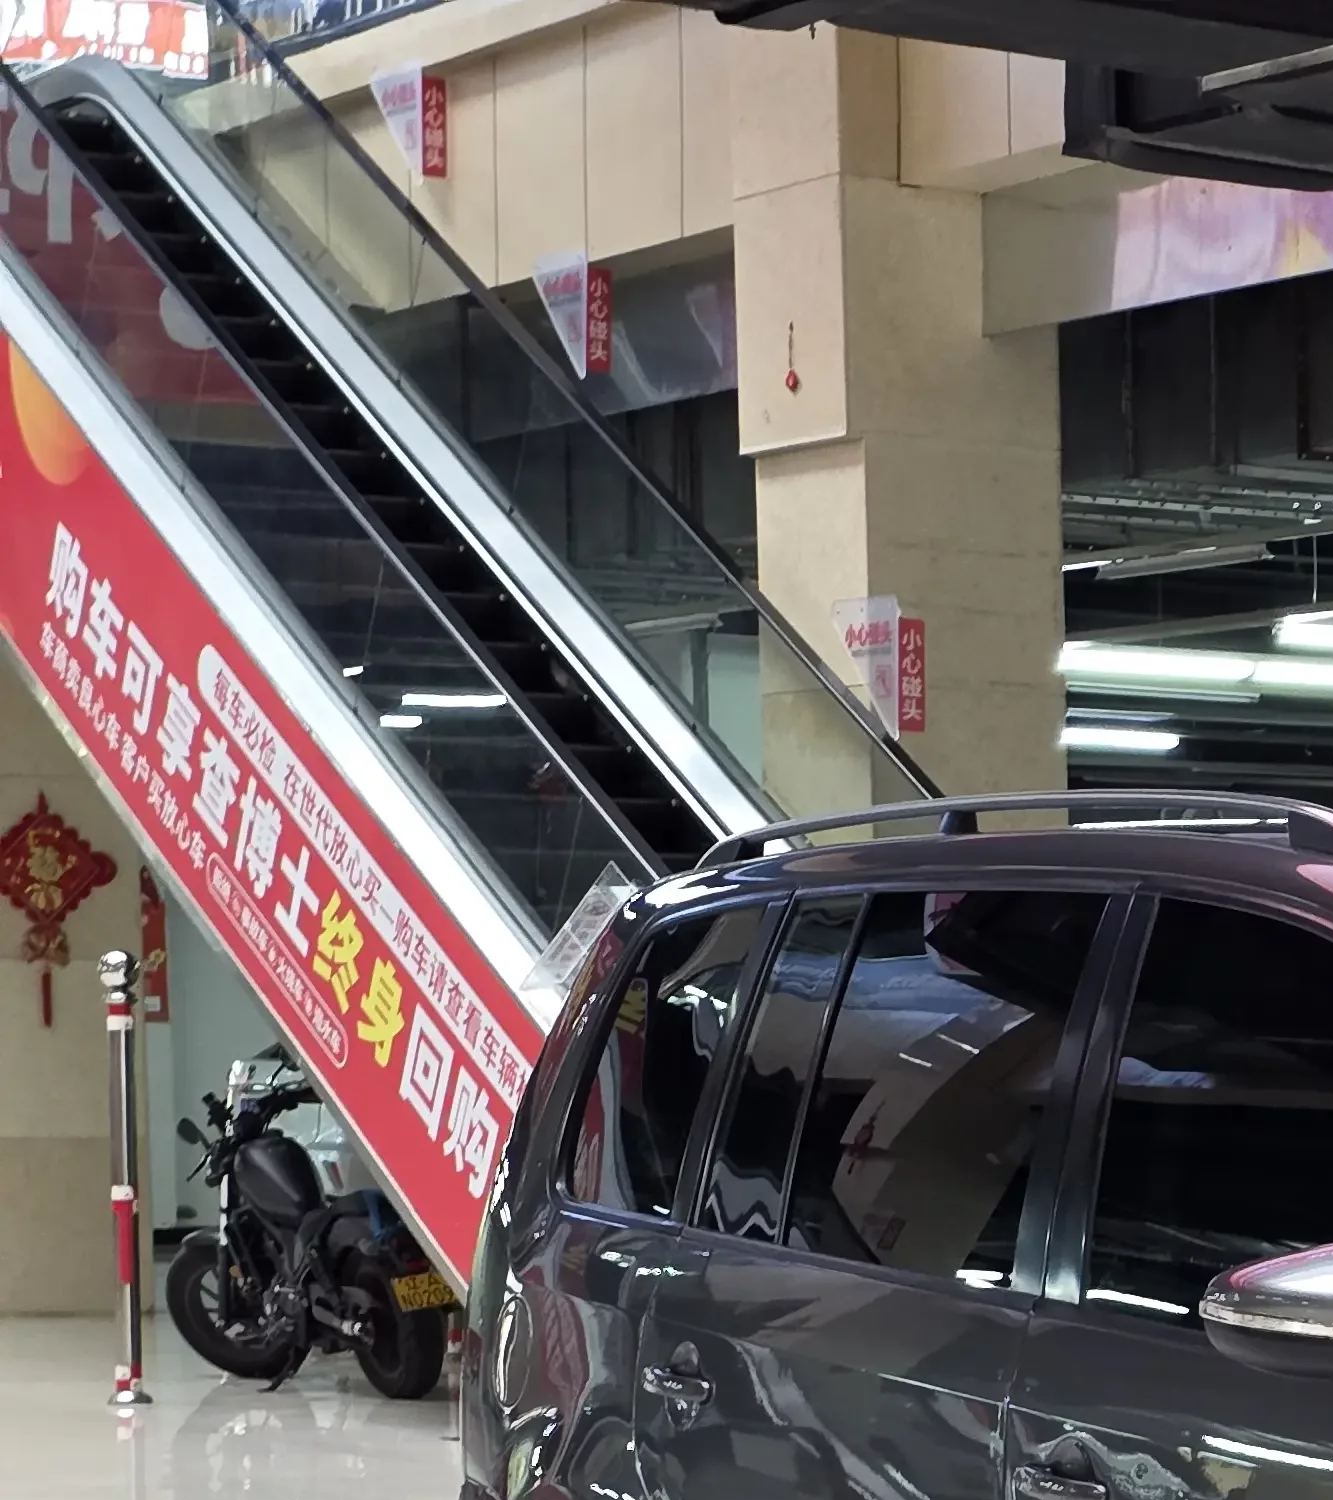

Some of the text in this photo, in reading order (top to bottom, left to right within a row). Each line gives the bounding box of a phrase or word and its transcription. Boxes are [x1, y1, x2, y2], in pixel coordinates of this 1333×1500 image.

[588, 276, 609, 361] 小心碰头
[901, 628, 923, 721] 小心碰头
[213, 668, 277, 775] 每车必检
